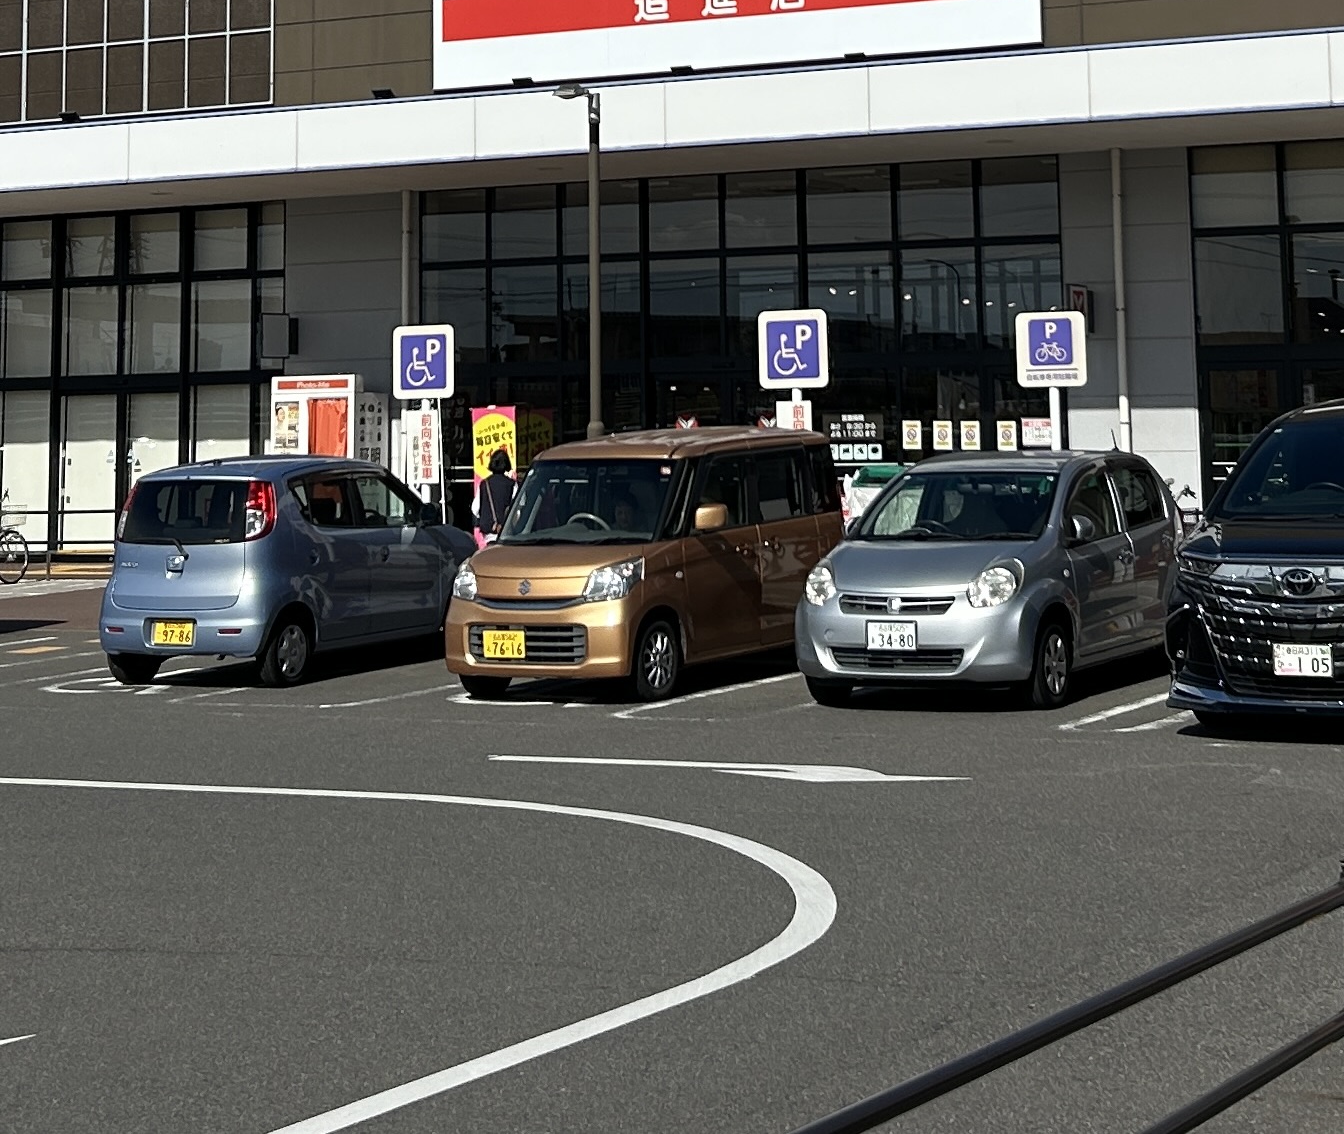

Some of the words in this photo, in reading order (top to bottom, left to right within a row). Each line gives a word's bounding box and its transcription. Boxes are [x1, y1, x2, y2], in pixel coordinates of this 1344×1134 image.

[795, 324, 812, 350] P
[1045, 322, 1057, 339] P
[426, 339, 441, 363] P
[422, 414, 433, 480] 前向き駐車
[162, 630, 191, 643] 97-86
[878, 633, 914, 647] 34-80
[492, 641, 523, 656] 76-16
